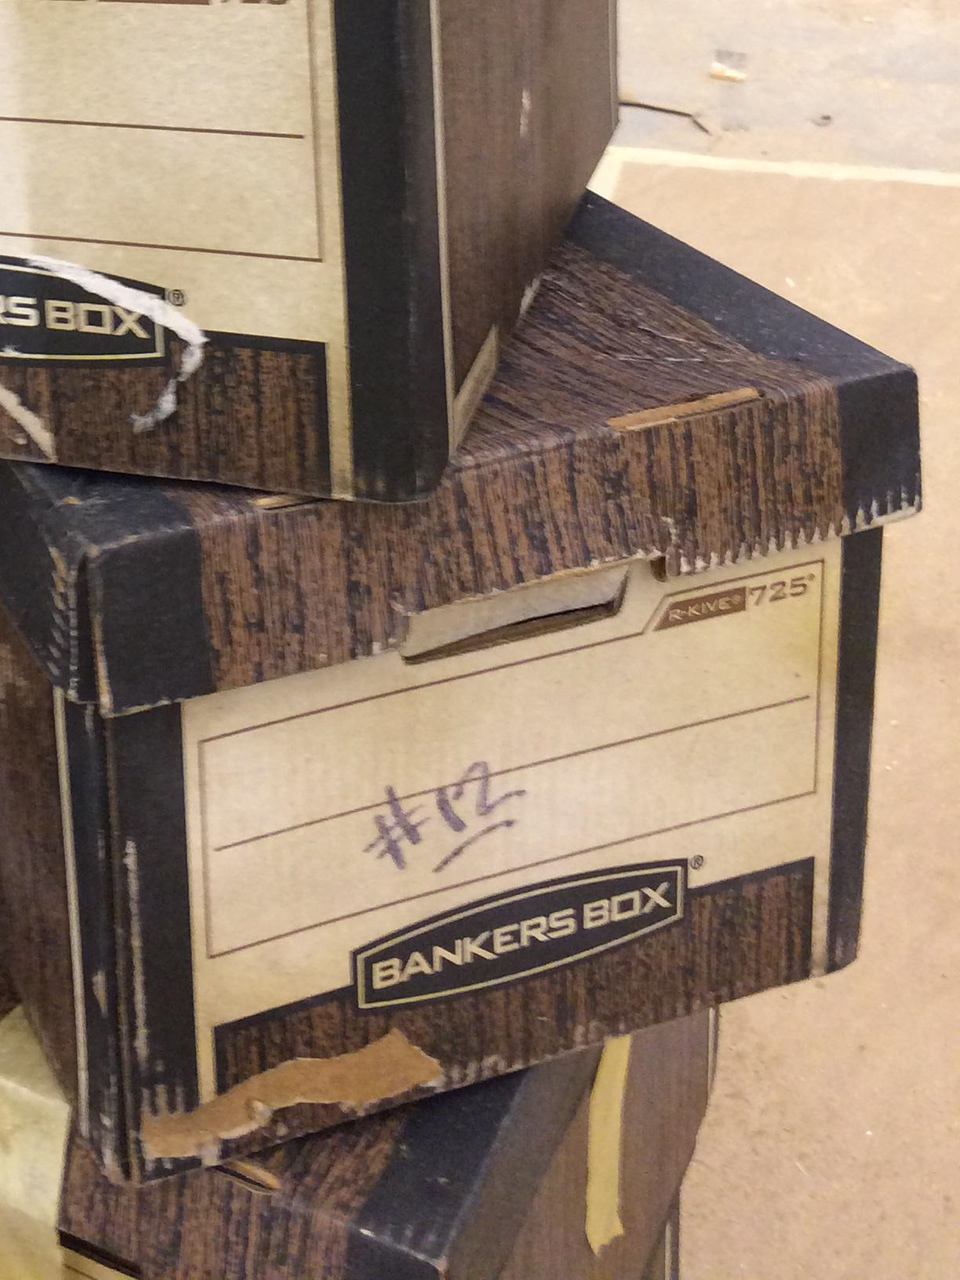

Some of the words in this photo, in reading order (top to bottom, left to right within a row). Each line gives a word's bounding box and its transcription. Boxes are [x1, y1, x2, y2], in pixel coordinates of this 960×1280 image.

[43, 298, 152, 340] BOX
[362, 760, 527, 871] #12
[372, 907, 578, 990] BANKERS
[583, 881, 674, 930] BOX
